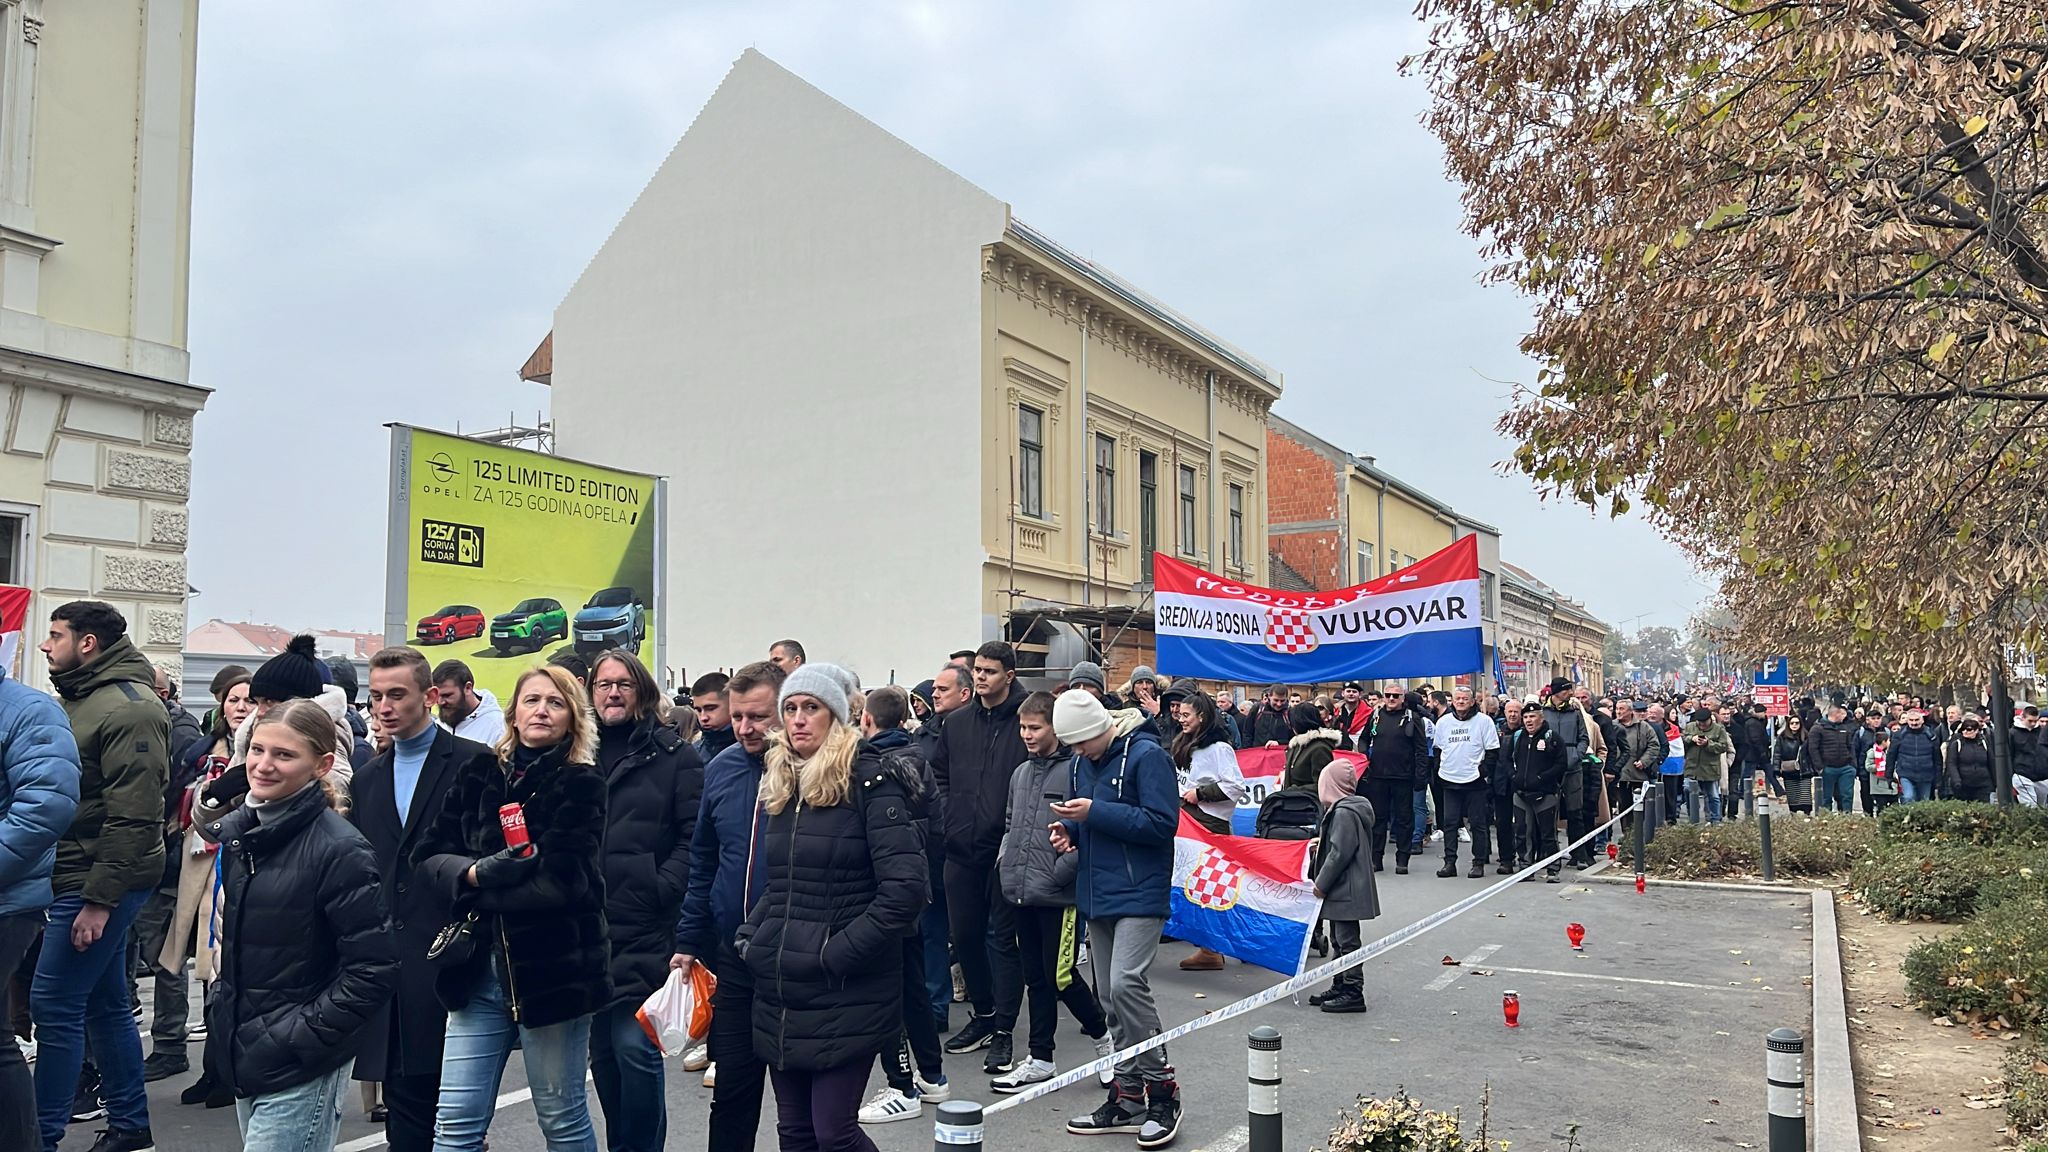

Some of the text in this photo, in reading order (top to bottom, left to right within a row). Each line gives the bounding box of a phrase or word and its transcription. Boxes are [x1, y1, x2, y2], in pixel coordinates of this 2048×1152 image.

[423, 485, 460, 499] OPEL
[473, 459, 639, 506] 125 LIMITED EDITION
[473, 485, 627, 525] ZA 125 GODINA OPELA
[423, 549, 455, 561] NA DAR
[424, 538, 455, 551] GORIVA
[1158, 605, 1261, 637] SREDNJA BOSNA
[1318, 596, 1468, 636] VUKOVAR
